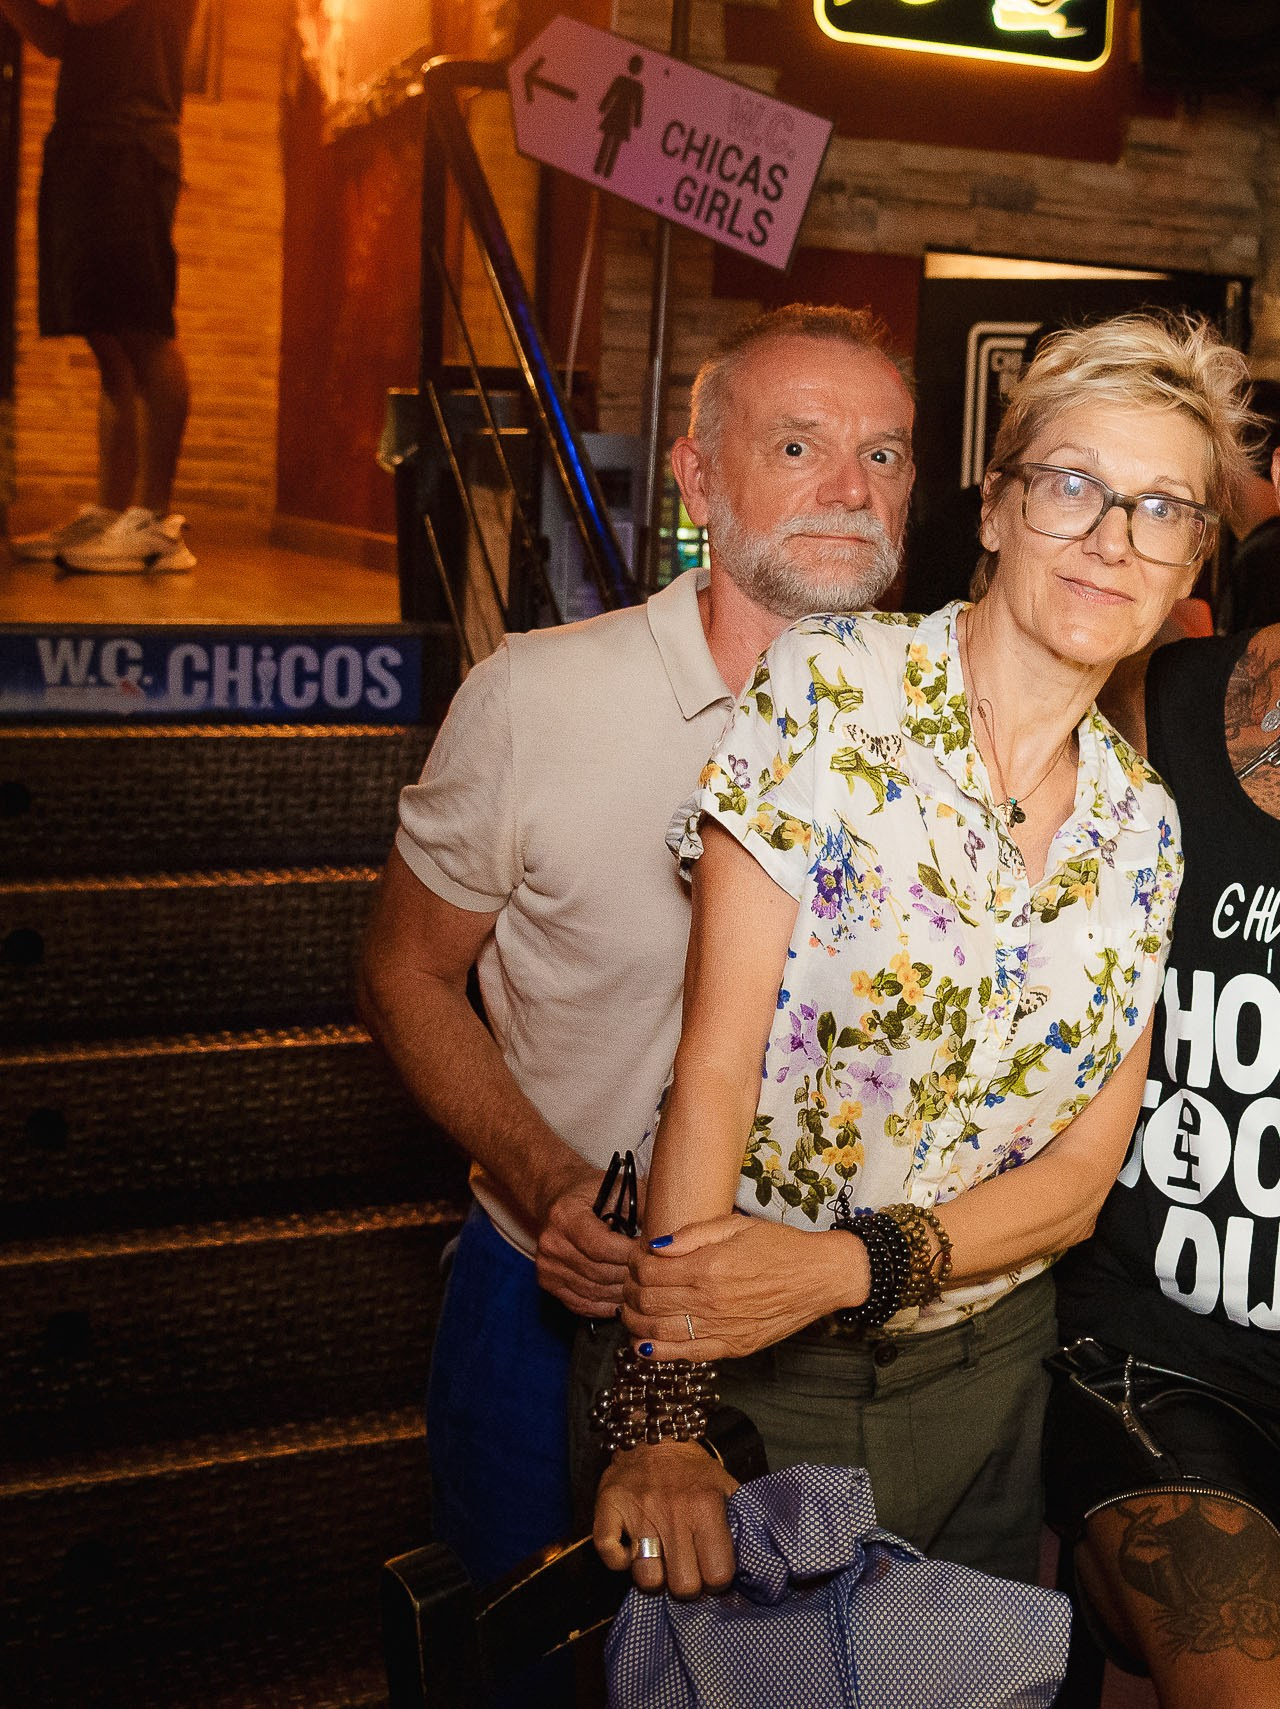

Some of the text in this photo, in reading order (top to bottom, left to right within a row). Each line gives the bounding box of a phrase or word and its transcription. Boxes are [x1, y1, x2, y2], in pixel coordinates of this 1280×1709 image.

[660, 119, 789, 203] CHICAS
[673, 175, 775, 248] GIRLS
[36, 638, 153, 686] W.C.
